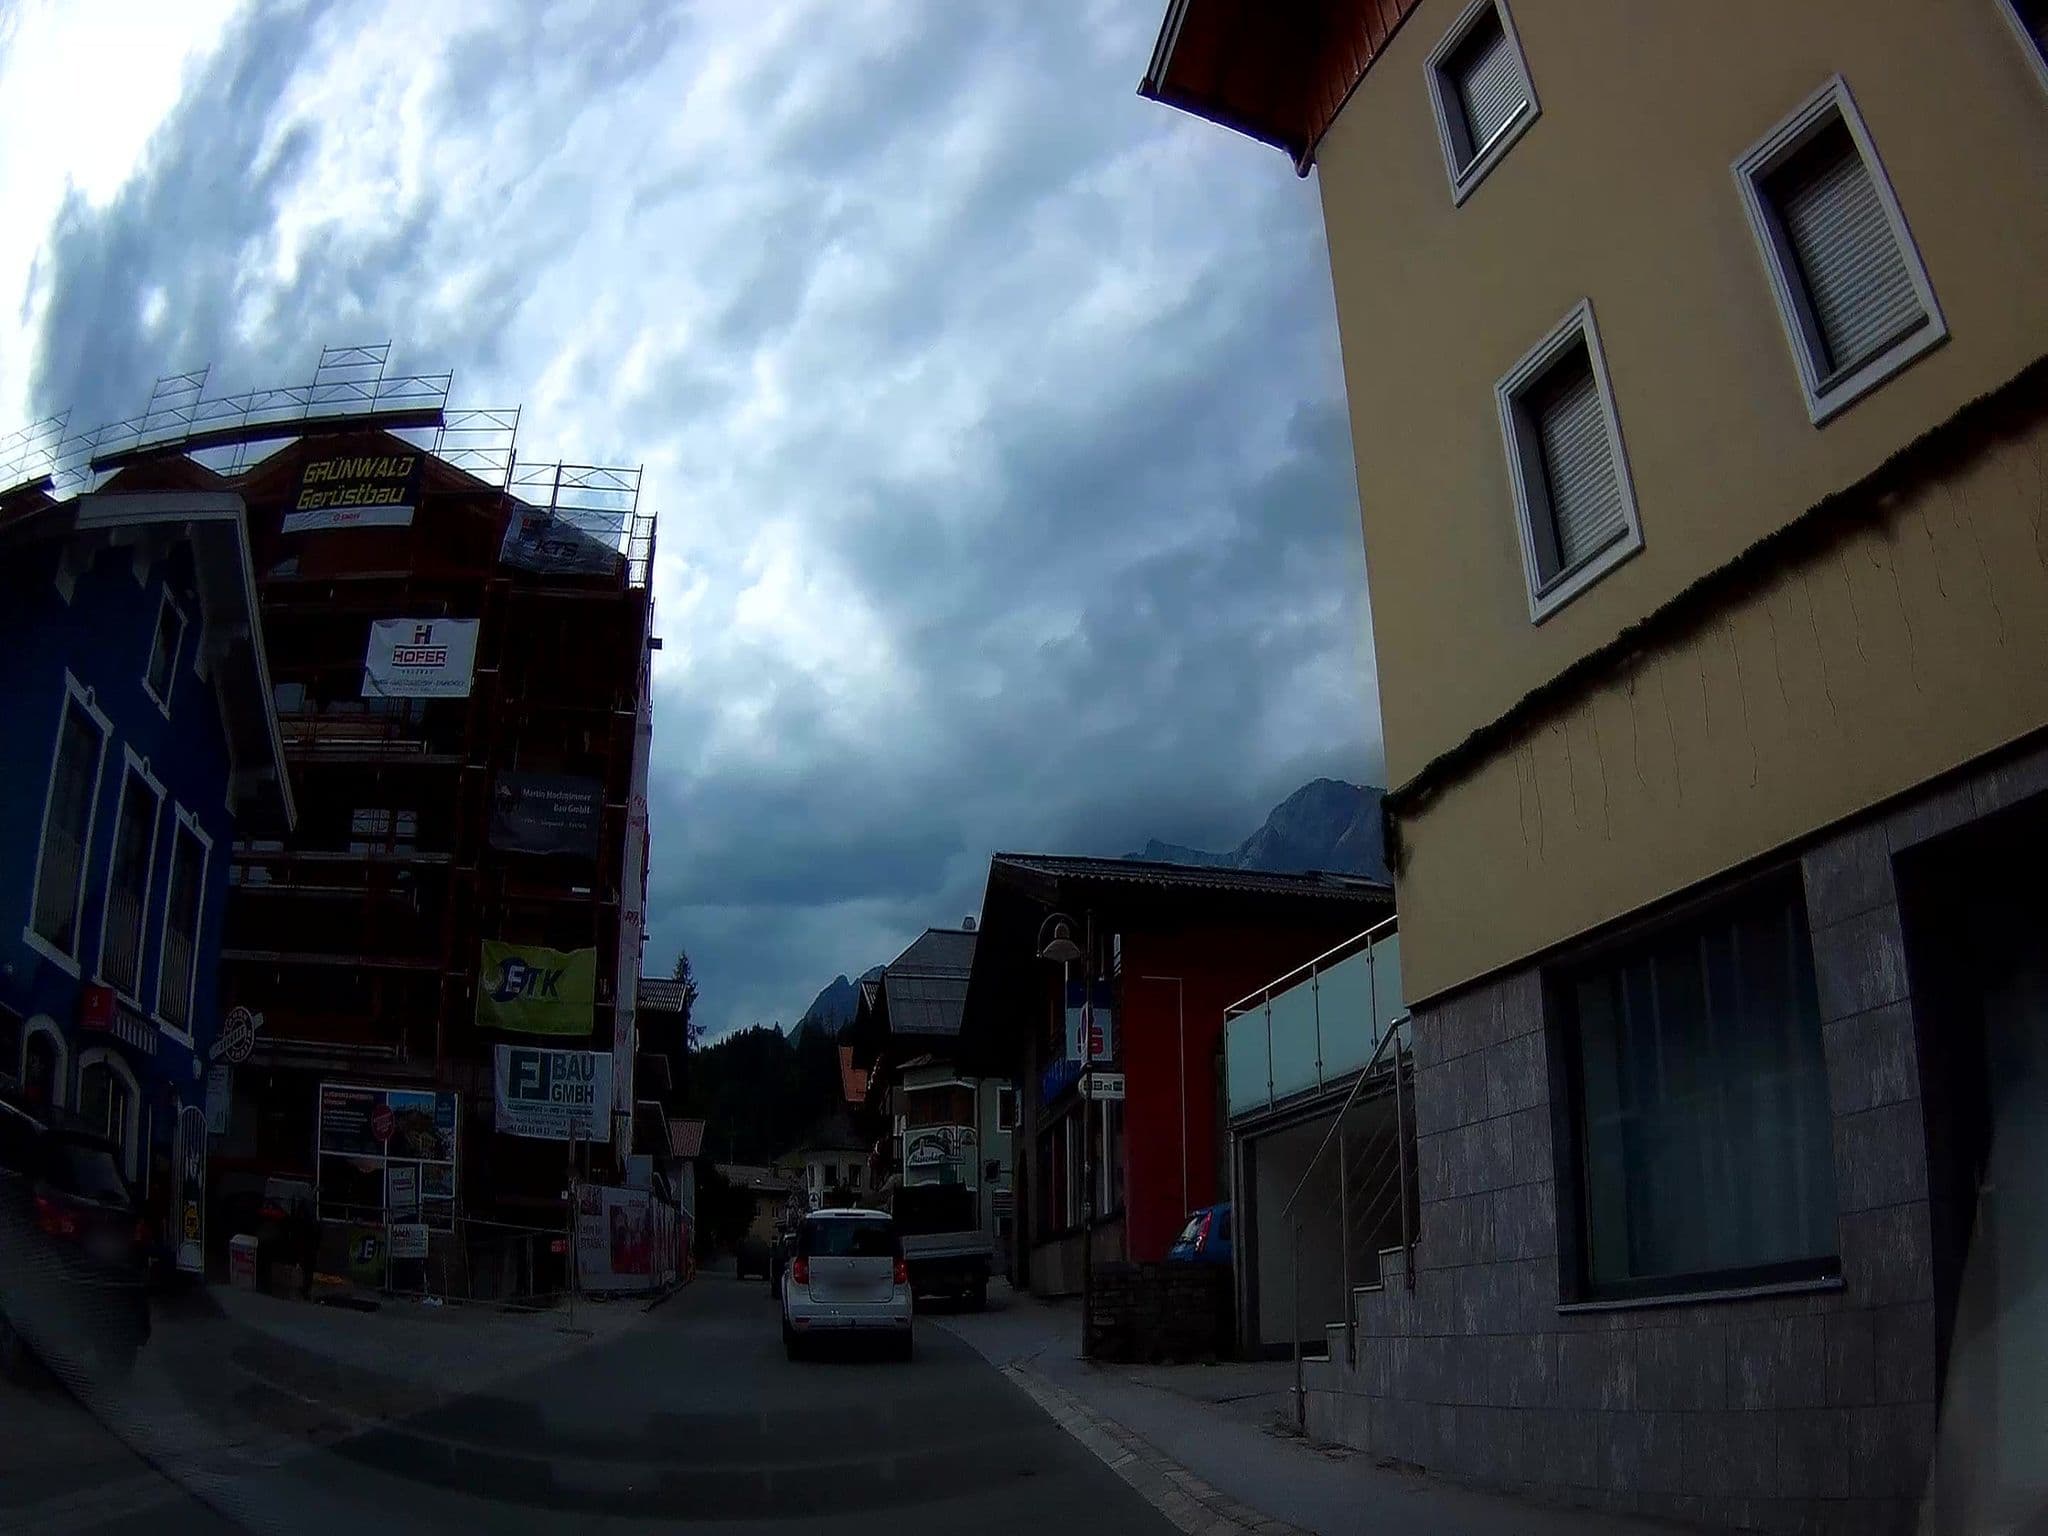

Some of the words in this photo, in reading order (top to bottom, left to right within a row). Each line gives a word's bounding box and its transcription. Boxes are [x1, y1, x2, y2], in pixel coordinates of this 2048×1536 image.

[302, 456, 415, 483] GRÜNWALD
[295, 483, 406, 510] Gerüstbau
[392, 650, 447, 662] HOFER
[504, 964, 566, 997] ETK
[552, 1053, 596, 1082] BAU
[551, 1083, 595, 1103] GMBH
